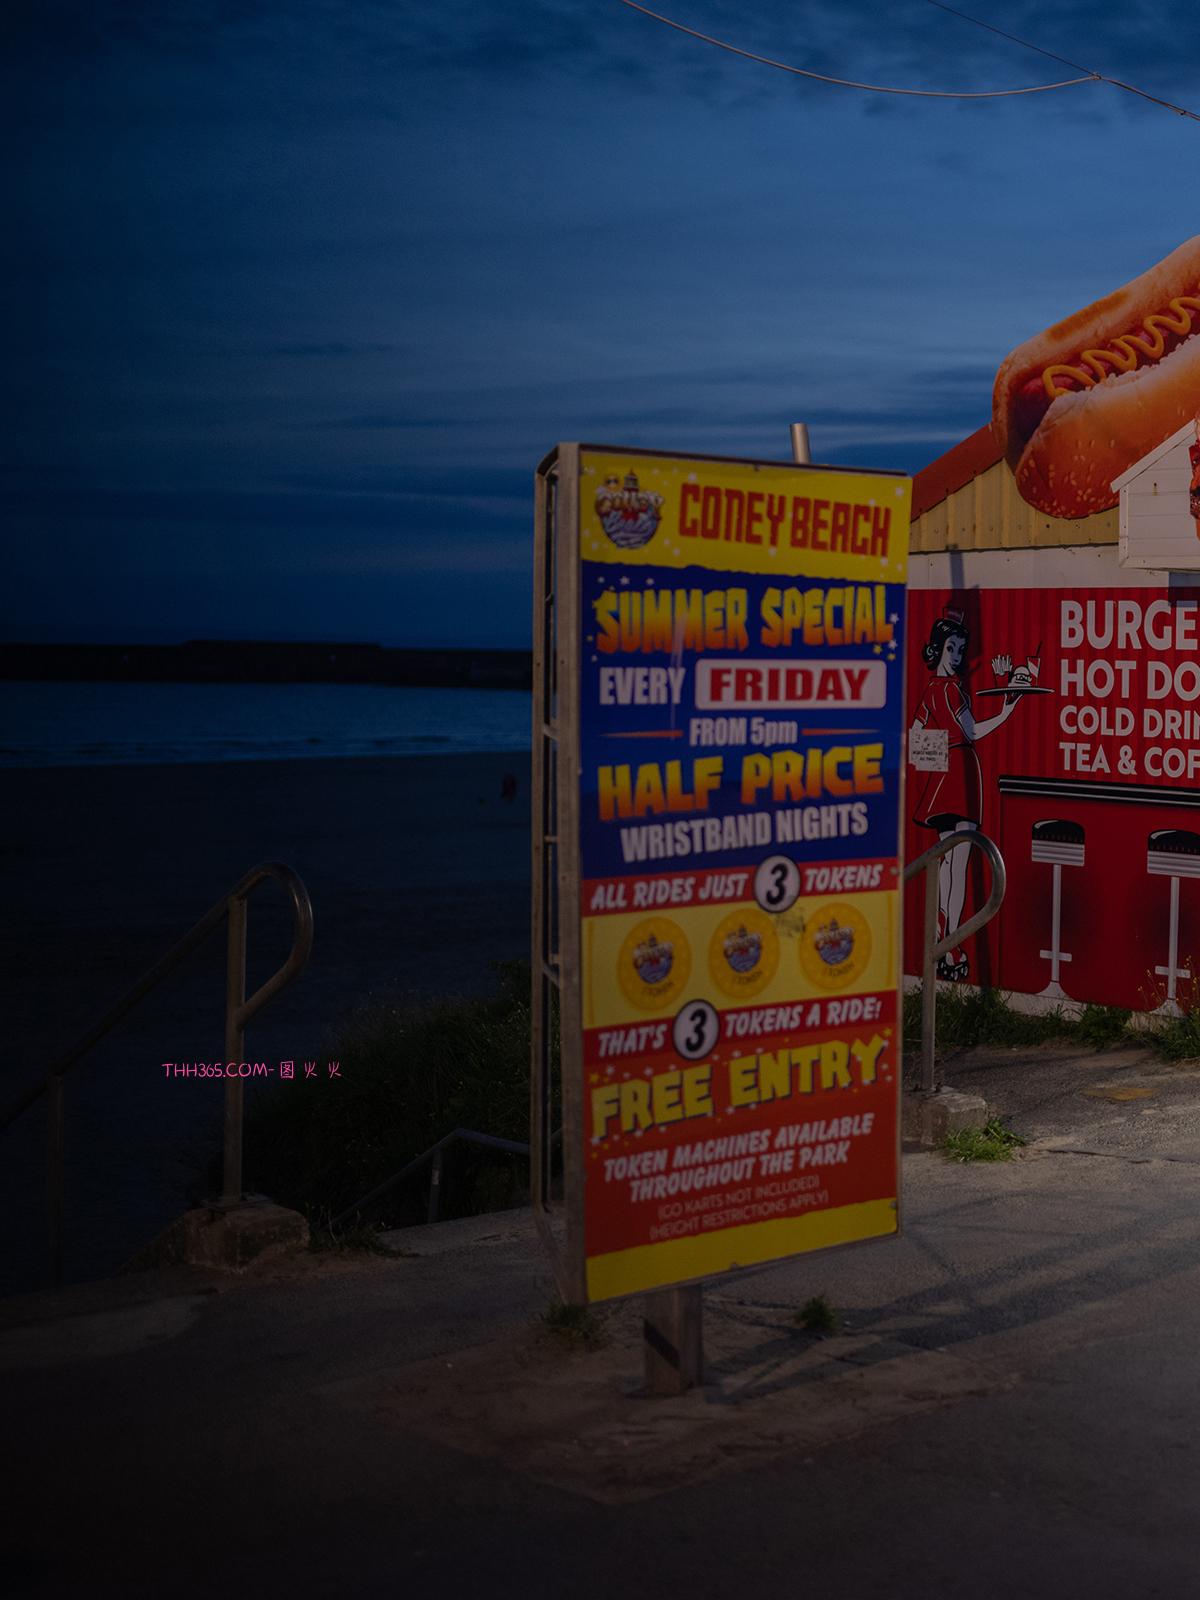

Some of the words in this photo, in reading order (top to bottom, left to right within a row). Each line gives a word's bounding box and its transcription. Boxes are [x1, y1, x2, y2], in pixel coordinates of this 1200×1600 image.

[679, 483, 785, 548] CONEY
[790, 499, 892, 557] BEACH
[592, 587, 749, 654] SUMMER
[760, 585, 893, 646] SPECIAL
[600, 666, 685, 704] EVERY
[709, 667, 871, 702] FRIDAY
[1059, 658, 1137, 698] HOT
[689, 718, 747, 747] FROM
[750, 718, 798, 745] 5pm
[1059, 704, 1136, 737] COLD
[597, 756, 724, 821] HALF
[740, 743, 885, 804] PRICE
[1058, 741, 1111, 774] TEA
[1117, 748, 1137, 776] &
[620, 812, 772, 863] WRISTBAND
[776, 801, 869, 842] NIGHTS
[590, 884, 630, 911] ALL
[633, 876, 696, 907] RIDES
[698, 873, 749, 900] JUST
[766, 863, 788, 905] 3
[804, 863, 884, 890] TOKENS
[599, 1024, 668, 1058] THAT'S
[686, 1008, 707, 1051] 3
[725, 1004, 803, 1036] TOKENS
[806, 1002, 823, 1026] A
[826, 997, 881, 1023] RIDE!
[590, 1063, 714, 1140] FREE
[731, 1034, 885, 1107] ENTRY
[604, 1148, 668, 1182] TOKEN
[673, 1129, 771, 1170] MACHINES
[775, 1113, 875, 1145] AVAILABLE
[630, 1160, 756, 1202] THROUGHOUT
[759, 1151, 796, 1175] THE
[799, 1141, 851, 1168] PARK
